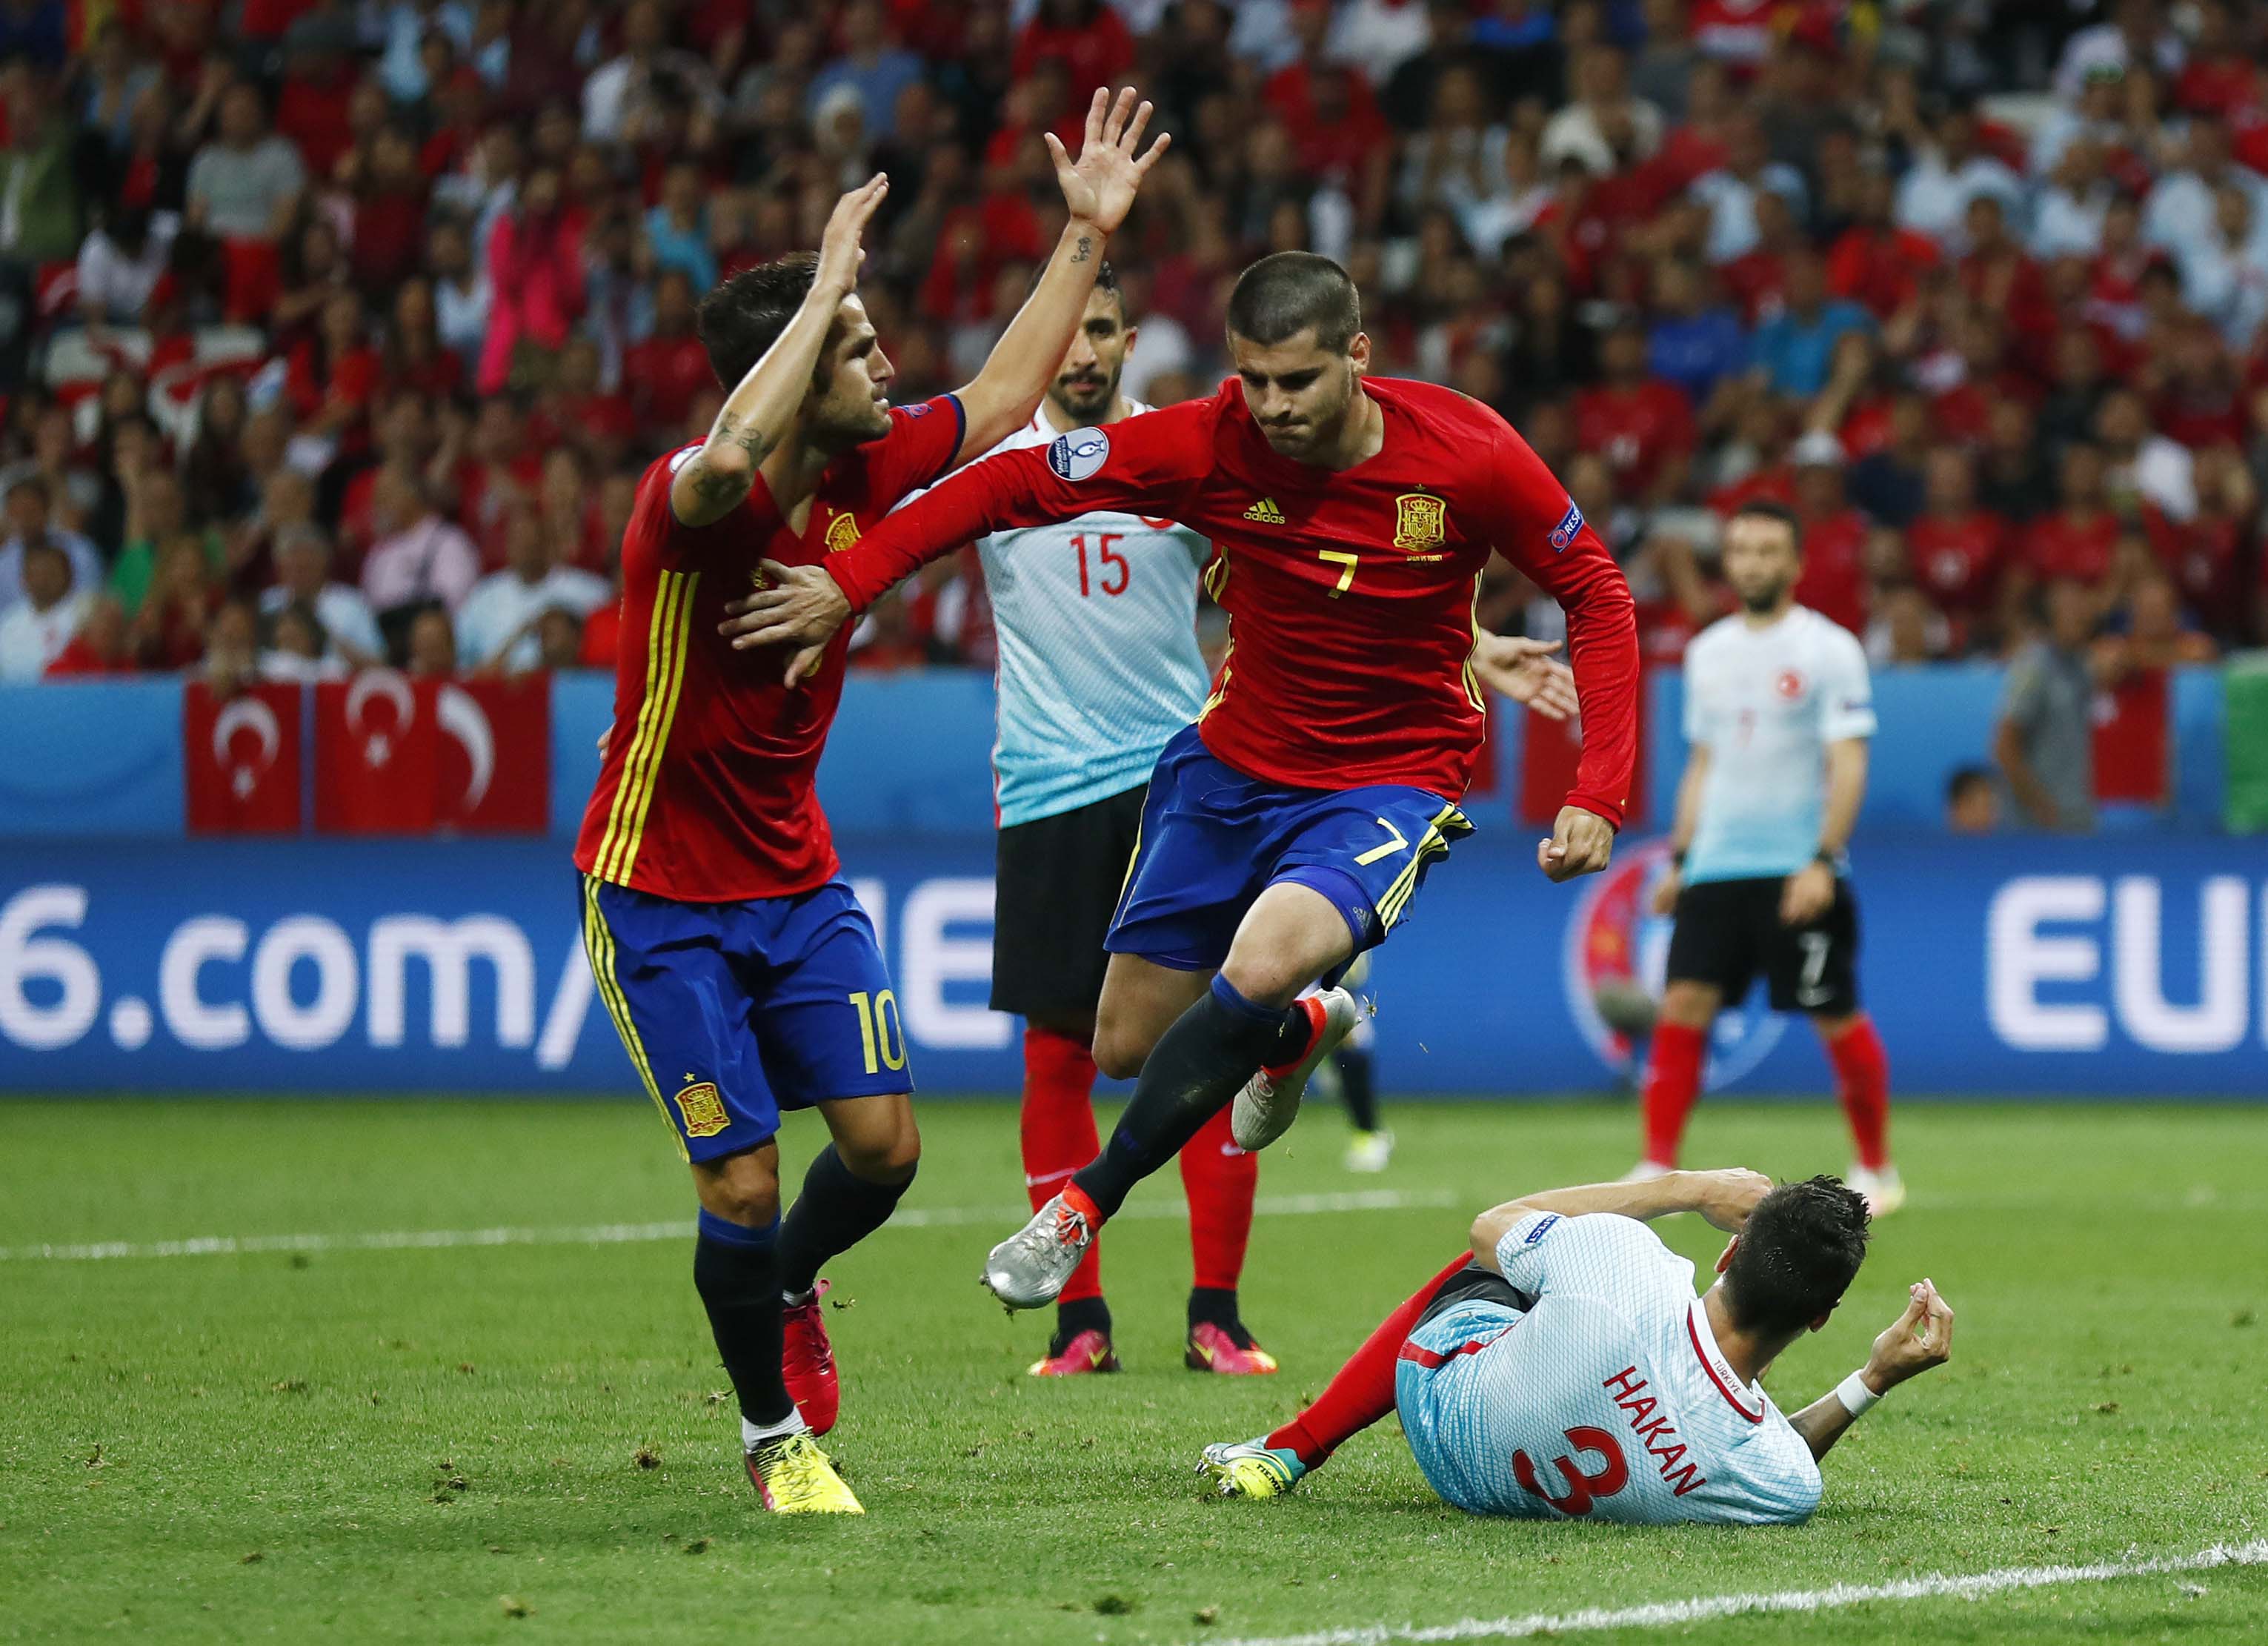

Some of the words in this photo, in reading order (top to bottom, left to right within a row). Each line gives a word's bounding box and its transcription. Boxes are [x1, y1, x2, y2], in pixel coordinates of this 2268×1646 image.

[1243, 510, 1286, 525] adidas
[1070, 533, 1130, 597] 15
[1318, 549, 1359, 600] 7
[1354, 817, 1409, 866] 7
[1798, 931, 1831, 987] 7
[1988, 875, 2268, 1053] EU
[848, 989, 905, 1075] 10
[1603, 1365, 1708, 1498] HAKAN
[1512, 1425, 1629, 1516] 3
